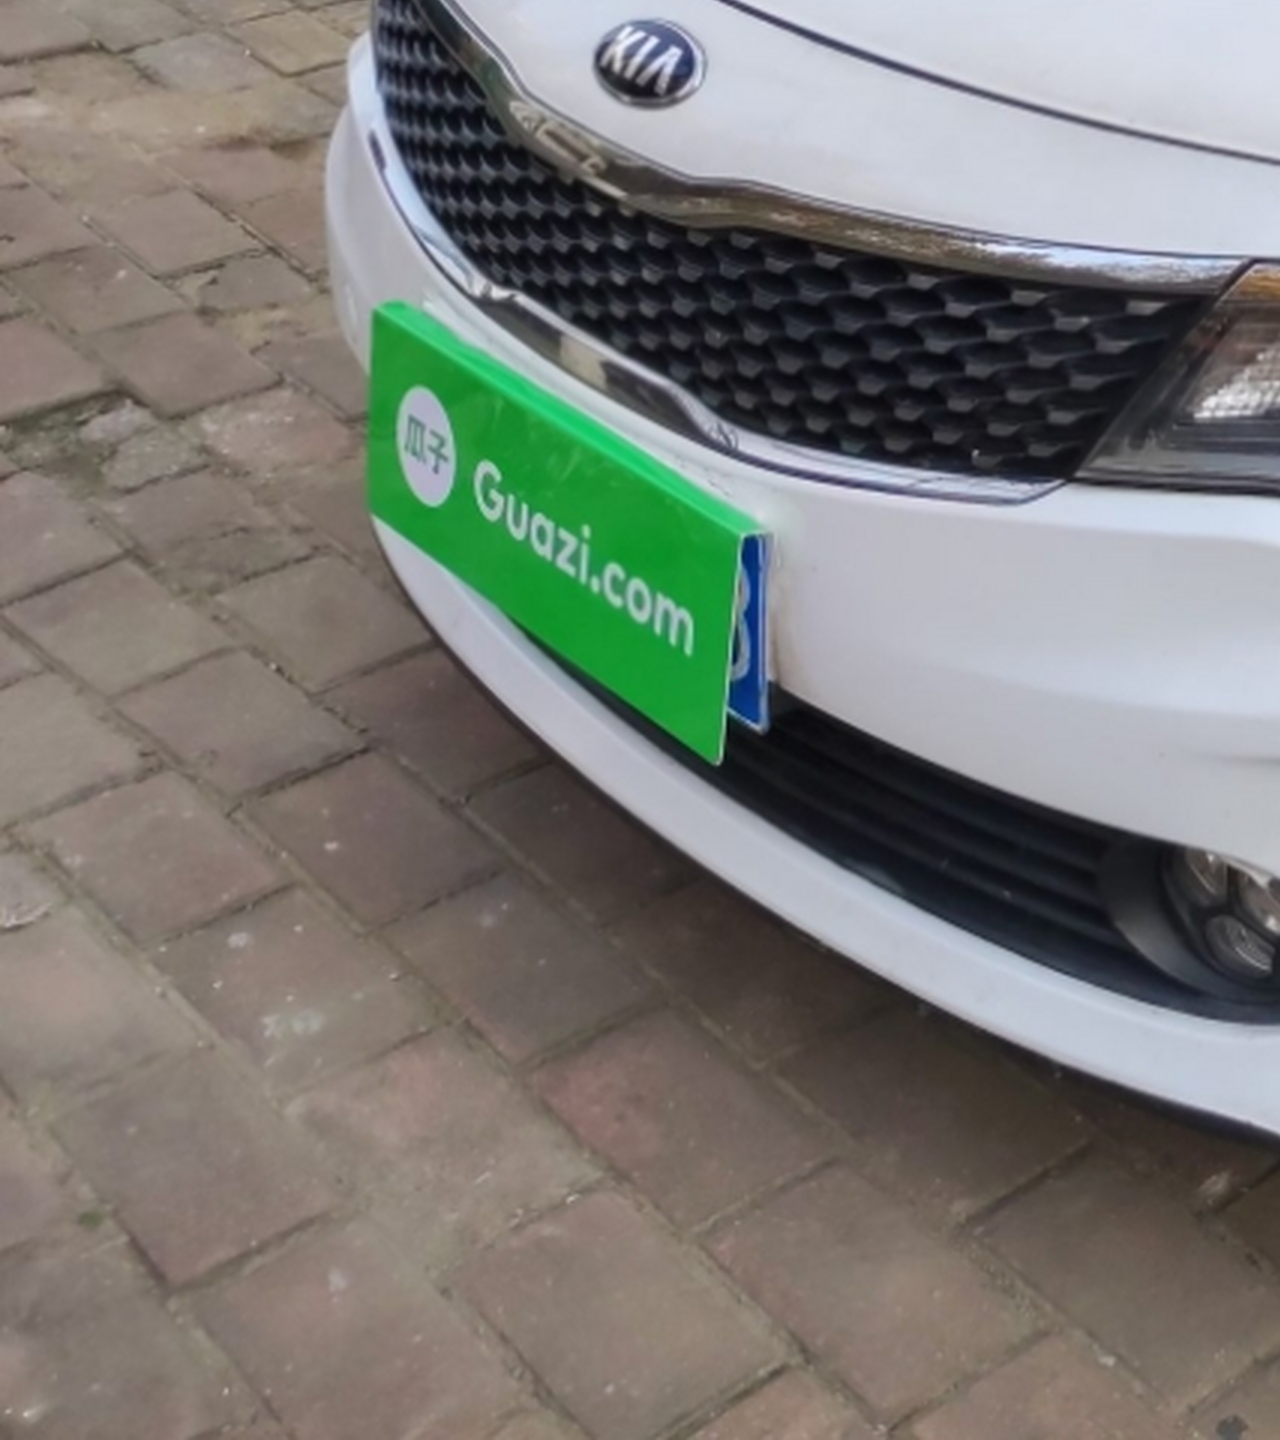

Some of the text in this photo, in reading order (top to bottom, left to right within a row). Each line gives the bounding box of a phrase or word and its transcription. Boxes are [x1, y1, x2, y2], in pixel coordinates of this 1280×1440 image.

[600, 25, 684, 97] KIA
[404, 413, 450, 475] 瓜子
[472, 459, 696, 657] Guazi.com
